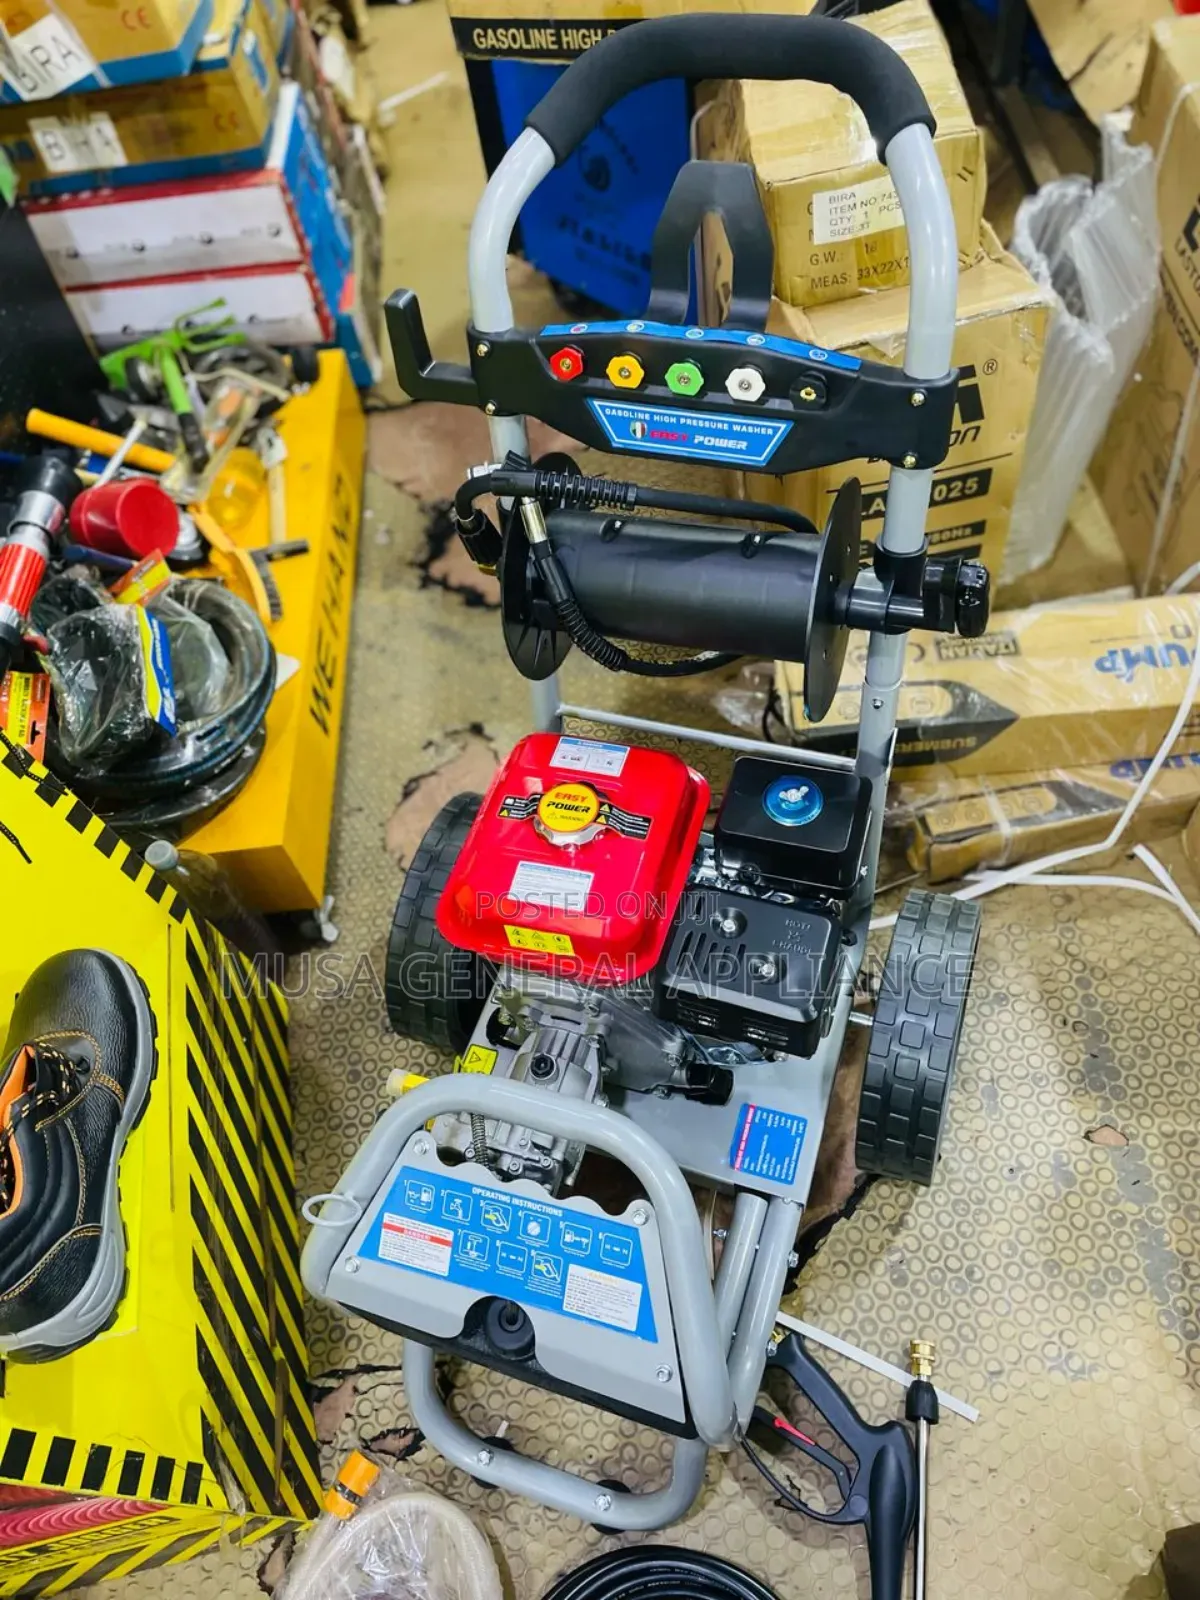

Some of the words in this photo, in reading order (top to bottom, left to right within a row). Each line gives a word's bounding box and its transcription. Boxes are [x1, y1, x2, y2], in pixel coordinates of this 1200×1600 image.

[473, 28, 559, 50] GASOLINE
[561, 29, 602, 50] HIGH
[828, 191, 857, 204] BIRA
[829, 202, 858, 216] ITEM
[879, 201, 902, 215] PCS
[810, 273, 851, 290] MEAS:
[605, 408, 651, 422] GASOLINE
[653, 413, 677, 425] HIGH
[680, 417, 730, 431] PRESSURE
[733, 423, 774, 436] WASHER
[693, 434, 748, 450] POWER
[1094, 642, 1194, 676] UMP
[554, 791, 589, 803] EASY
[546, 801, 591, 814] POWER
[471, 1186, 511, 1205] OPERATING
[511, 1198, 563, 1218] INSTRUCTIONS
